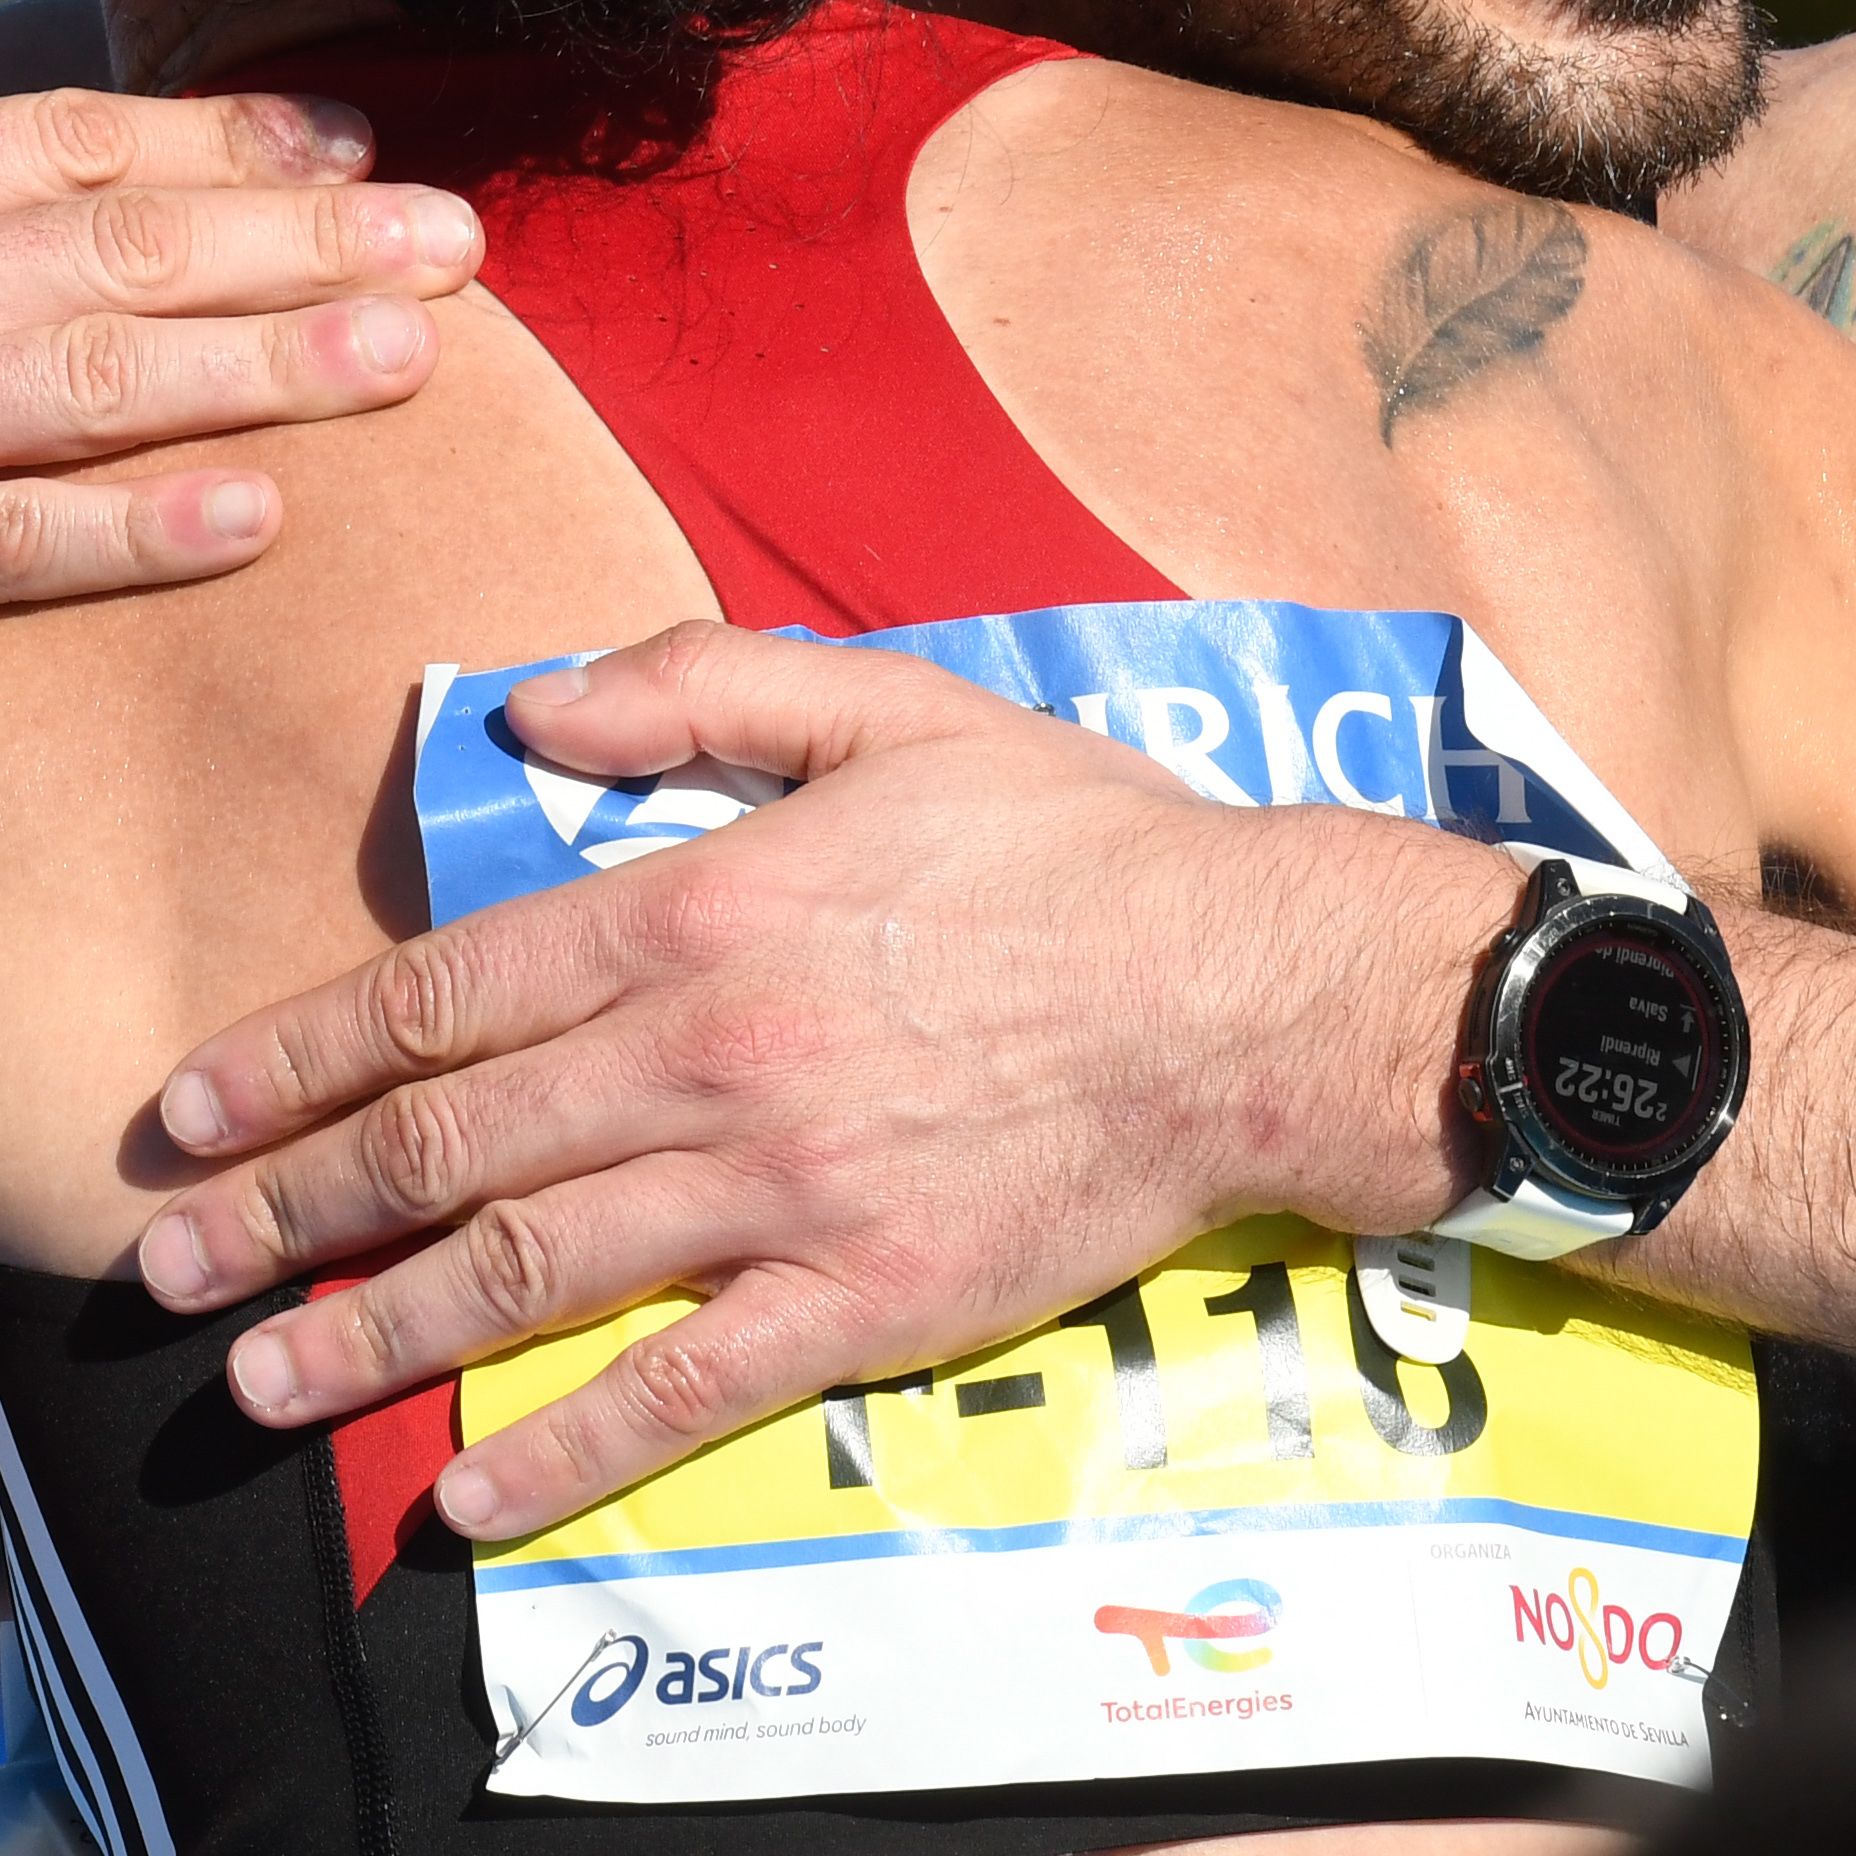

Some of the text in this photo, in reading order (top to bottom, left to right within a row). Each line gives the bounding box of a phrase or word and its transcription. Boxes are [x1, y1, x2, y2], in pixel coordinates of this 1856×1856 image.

[1071, 682, 1533, 825] RICH
[1629, 997, 1668, 1022] Salva
[1600, 1034, 1661, 1066] Riprendi
[1591, 1109, 1621, 1126] TIMER
[1430, 1543, 1512, 1560] ORGANIZA
[1100, 1689, 1294, 1724] TotalEnergies
[646, 1714, 867, 1747] sound mind, sound body
